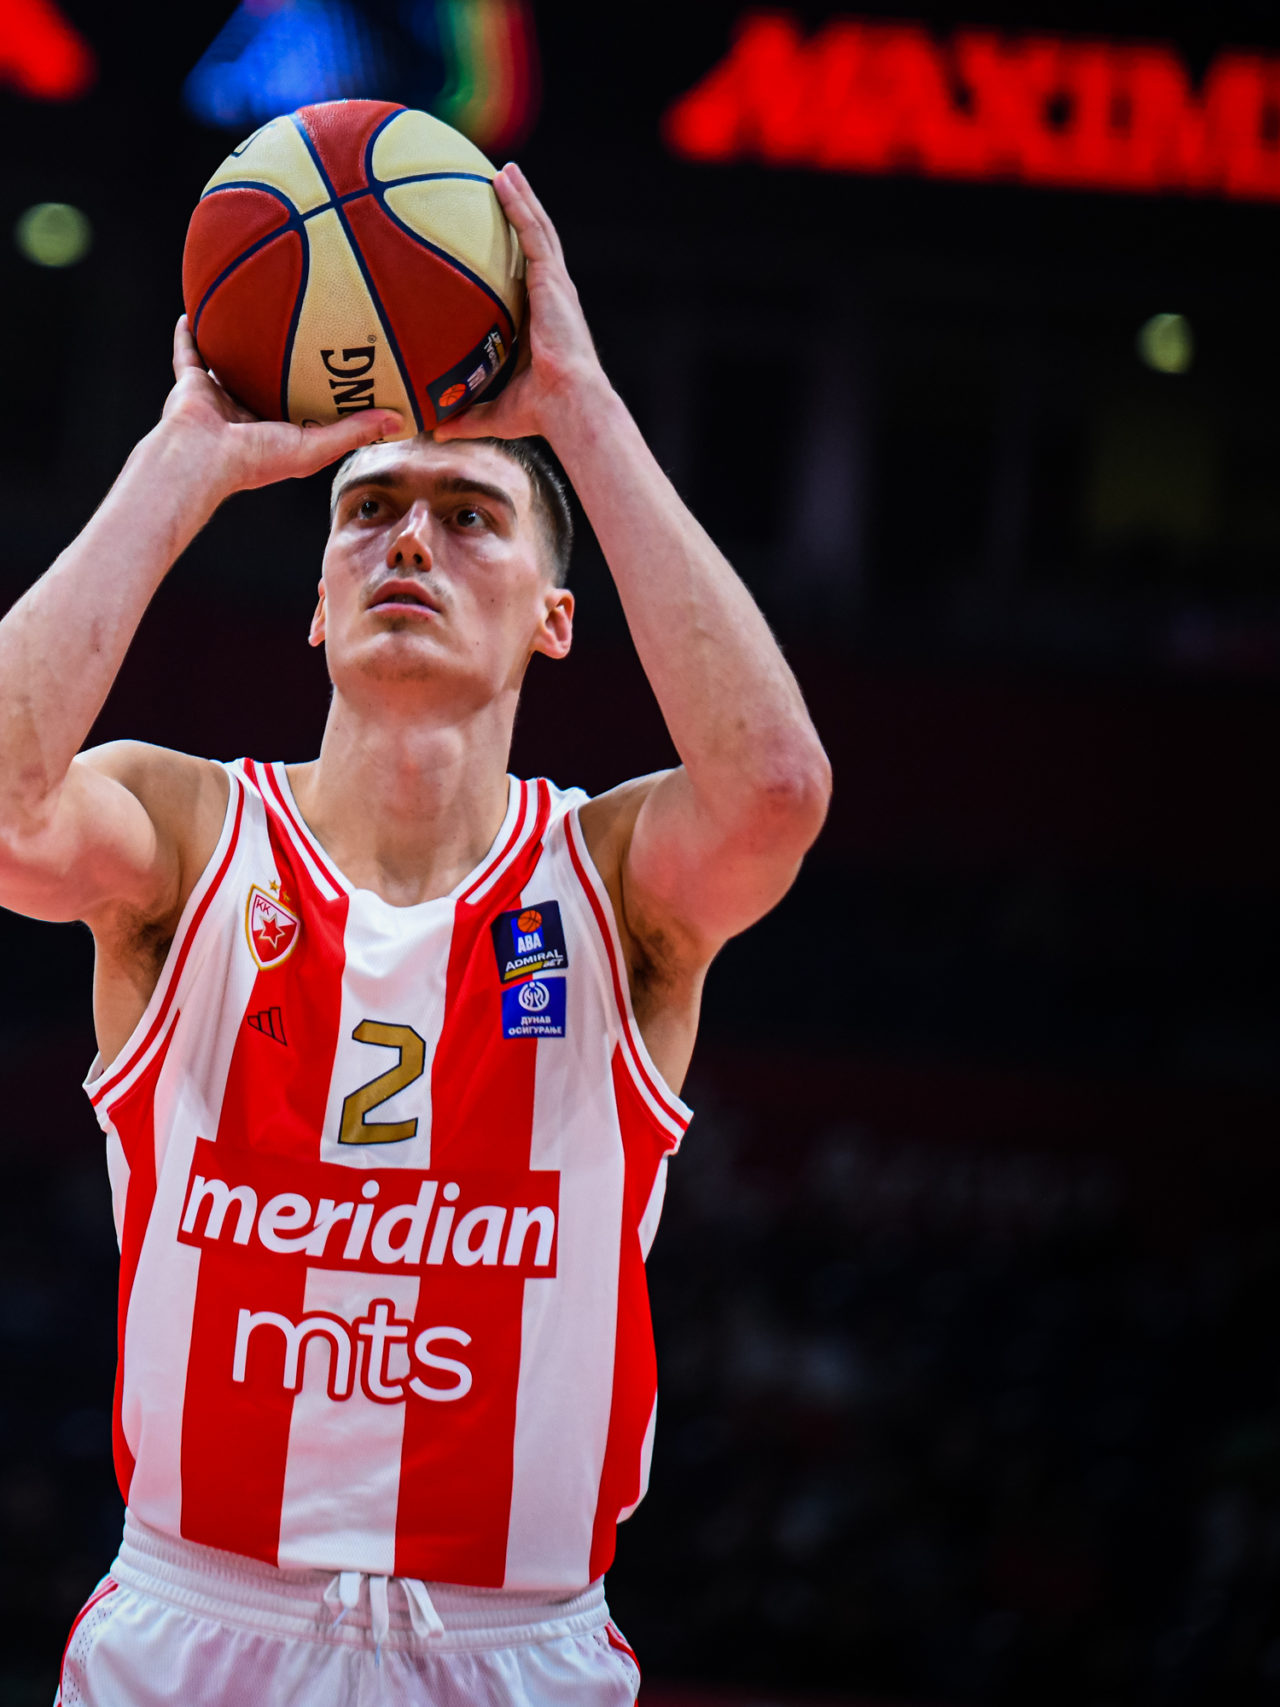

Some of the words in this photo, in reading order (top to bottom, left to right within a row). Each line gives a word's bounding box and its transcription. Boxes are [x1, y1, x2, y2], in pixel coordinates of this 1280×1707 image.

[505, 949, 564, 972] ADMIRAL
[517, 932, 543, 954] ABA
[521, 1016, 552, 1026] ДУНАВ
[338, 1018, 426, 1144] 2
[181, 1174, 556, 1267] meridian
[231, 1303, 473, 1402] mts
